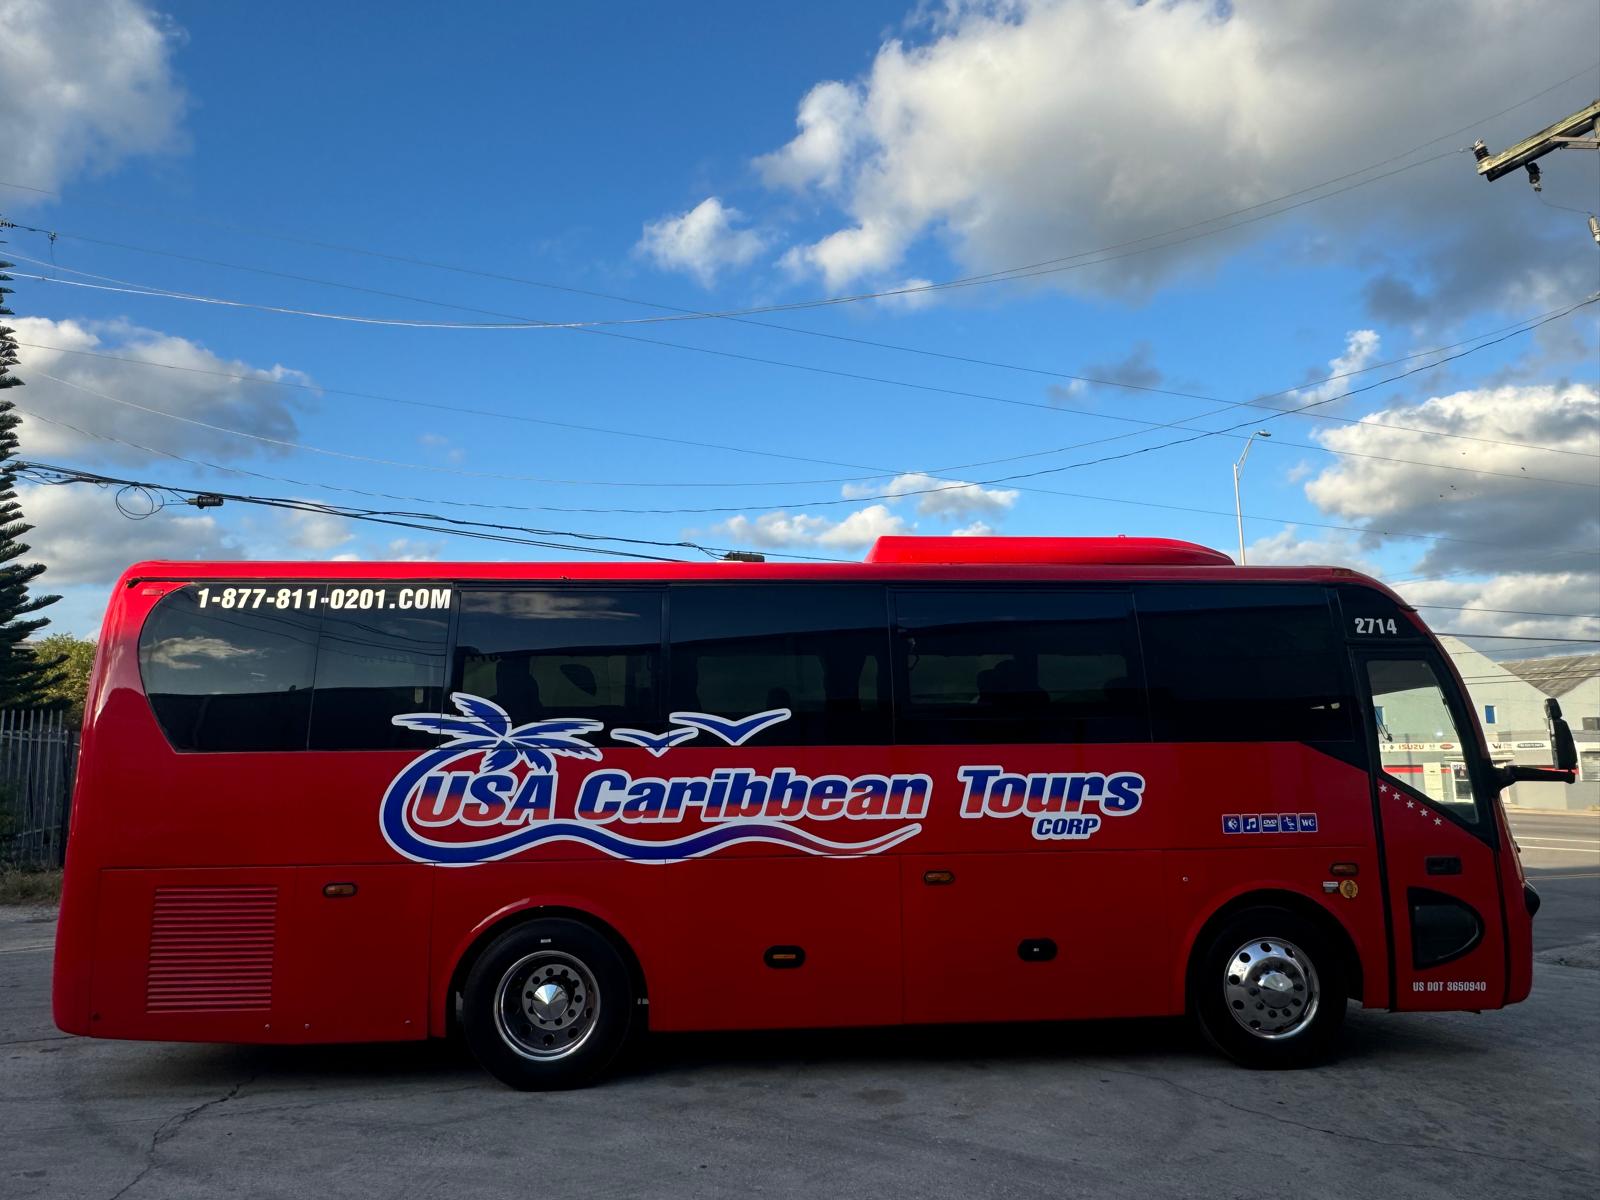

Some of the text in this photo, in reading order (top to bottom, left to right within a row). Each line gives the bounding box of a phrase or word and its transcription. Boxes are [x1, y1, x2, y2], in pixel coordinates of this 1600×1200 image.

[197, 587, 451, 609] 1-877-811-0201.COM
[1354, 617, 1397, 634] 2714
[413, 766, 1145, 825] USA Caribbean Tours
[1034, 816, 1100, 838] CORP
[1301, 818, 1315, 827] WC
[1412, 981, 1487, 991] US DOT 3650940
